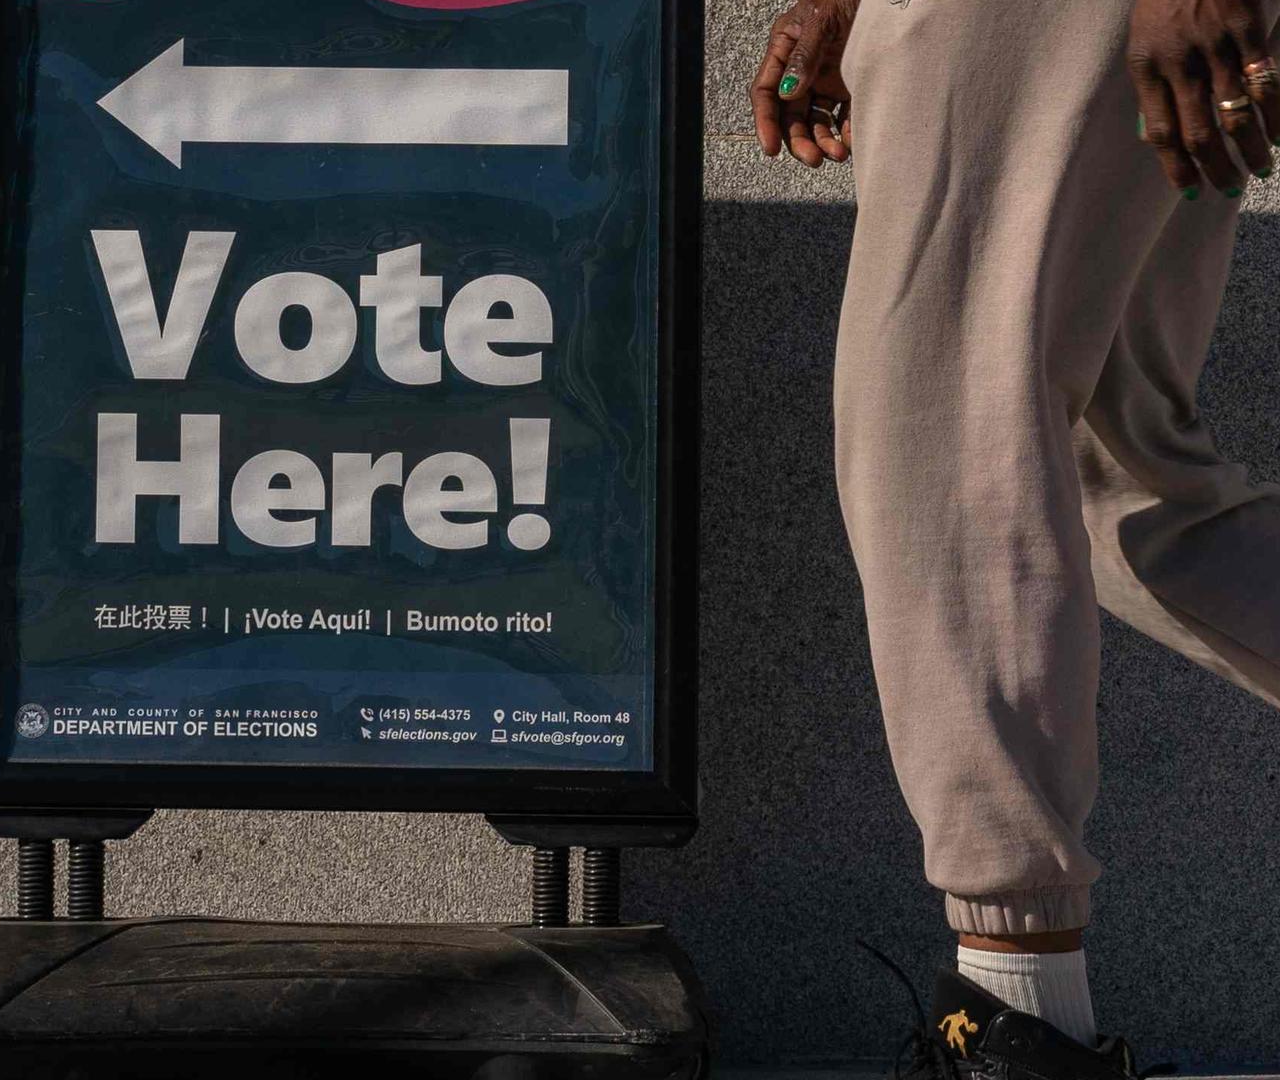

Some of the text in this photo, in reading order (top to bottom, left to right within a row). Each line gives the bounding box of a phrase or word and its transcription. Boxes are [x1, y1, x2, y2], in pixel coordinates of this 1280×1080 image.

[89, 229, 553, 386] Vote
[95, 412, 551, 551] Here!
[94, 604, 207, 630] 在此投票！
[244, 607, 304, 633] ¡Vote
[308, 608, 371, 636] Aquí!
[407, 610, 499, 633] Bumoto
[506, 611, 552, 633] rito!
[53, 707, 319, 719] CITY AND COUNTY OF SAN FRANCISCO
[378, 708, 471, 723] (415) 554-4375
[511, 710, 631, 725] City Hall, Room 48
[53, 719, 179, 736] DEPARTMENT
[183, 720, 209, 737] OF
[213, 721, 318, 738] ELECTIONS
[378, 727, 478, 744] sfelections.gov
[510, 730, 626, 747] sfvote@sfgov.org
